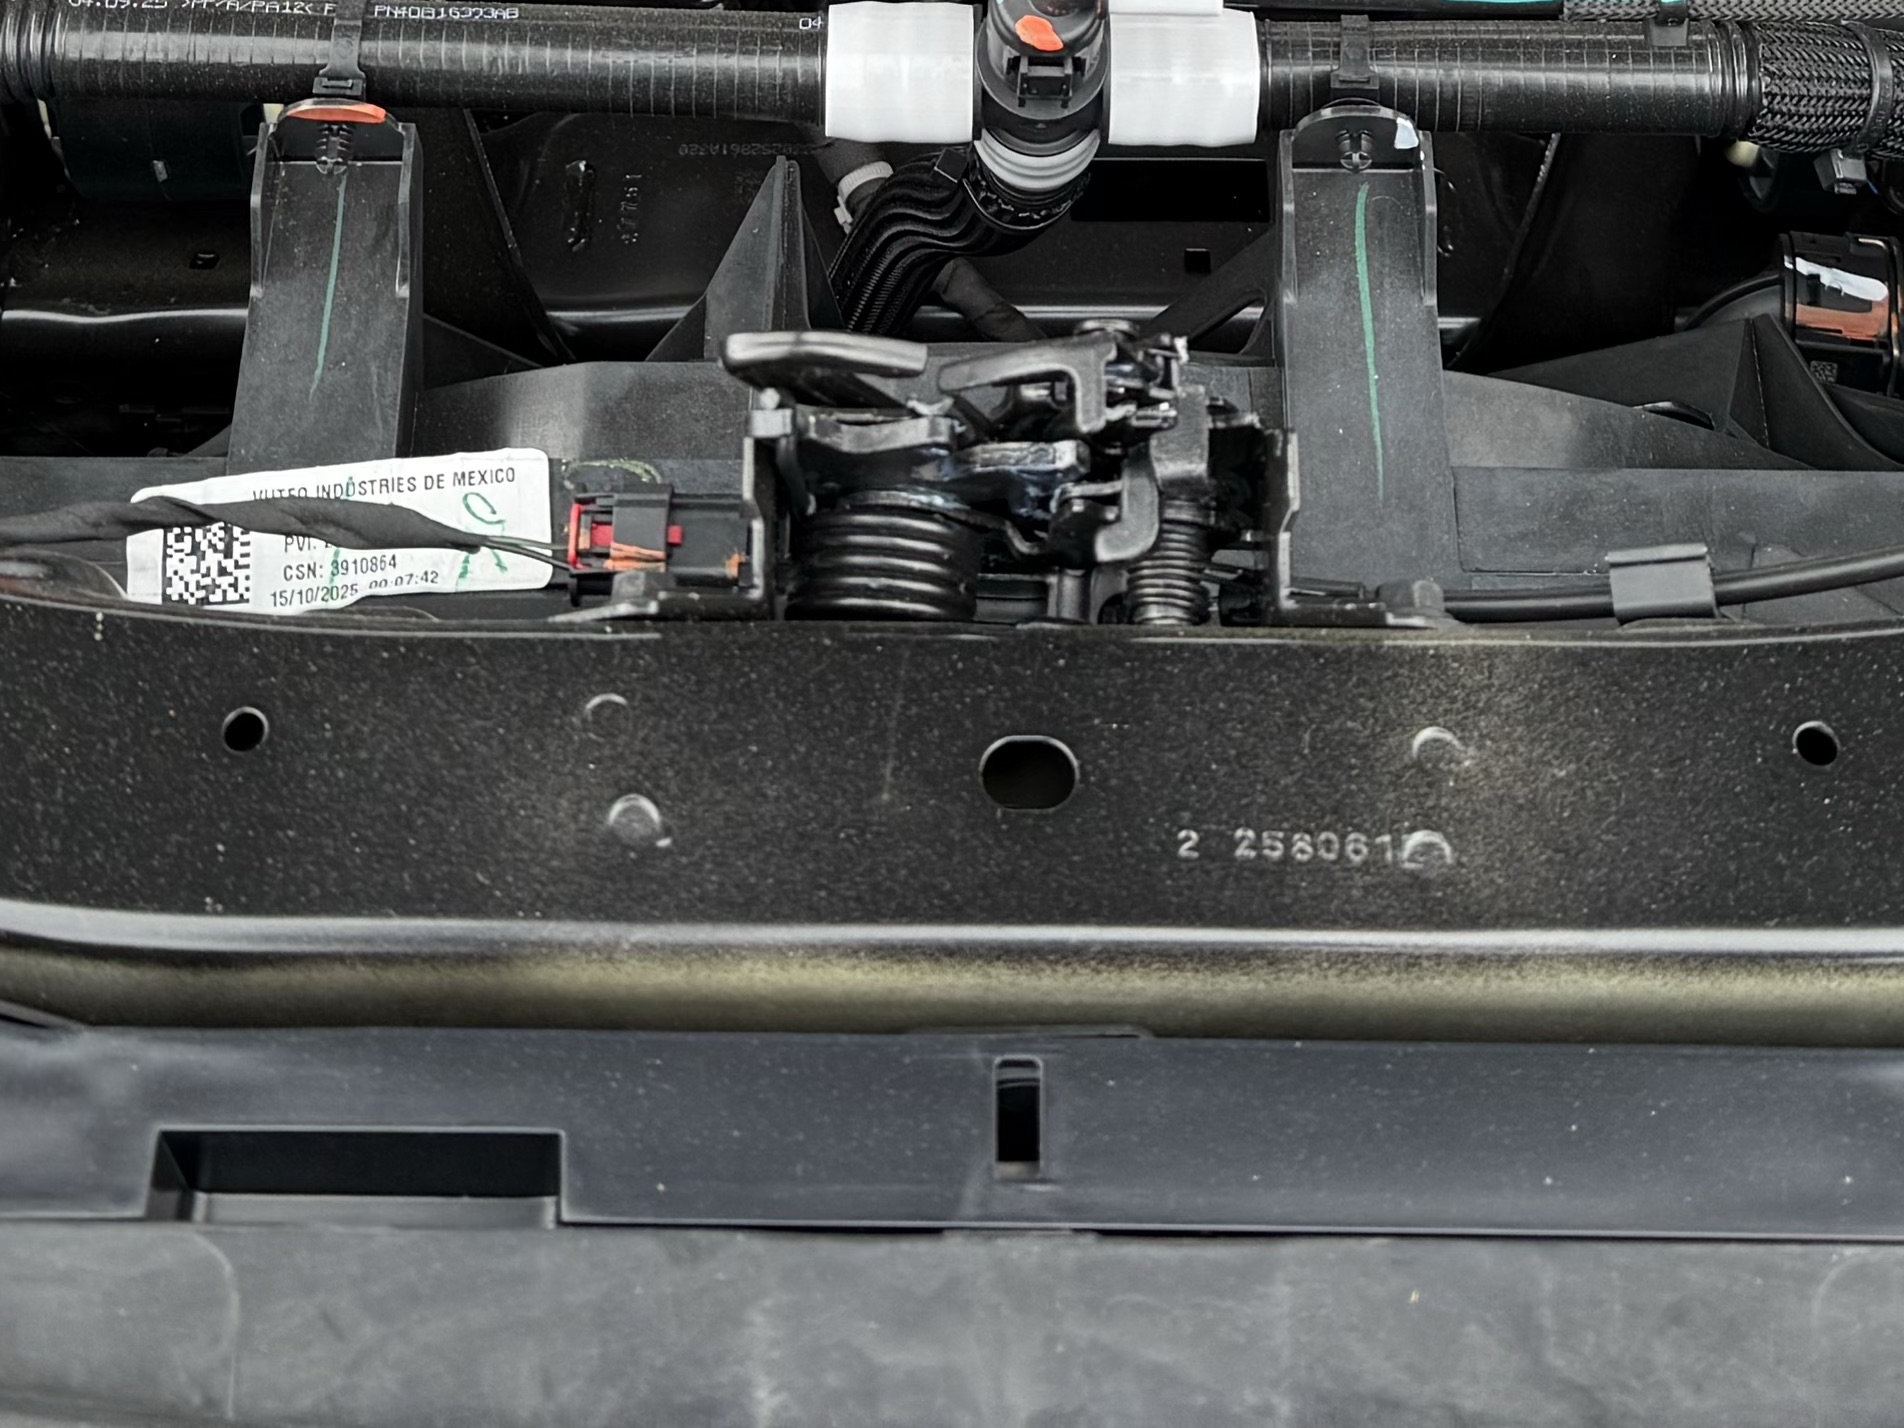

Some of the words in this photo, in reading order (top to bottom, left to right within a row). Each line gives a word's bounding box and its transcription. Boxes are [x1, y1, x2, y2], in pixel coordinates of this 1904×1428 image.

[315, 477, 417, 500] INDUSTRIES
[424, 475, 446, 490] DE
[452, 467, 516, 487] MEXICO
[283, 563, 324, 582] CSN:
[329, 554, 398, 579] 3910864
[269, 584, 359, 608] 15/10/2025
[1176, 828, 1200, 859] 2
